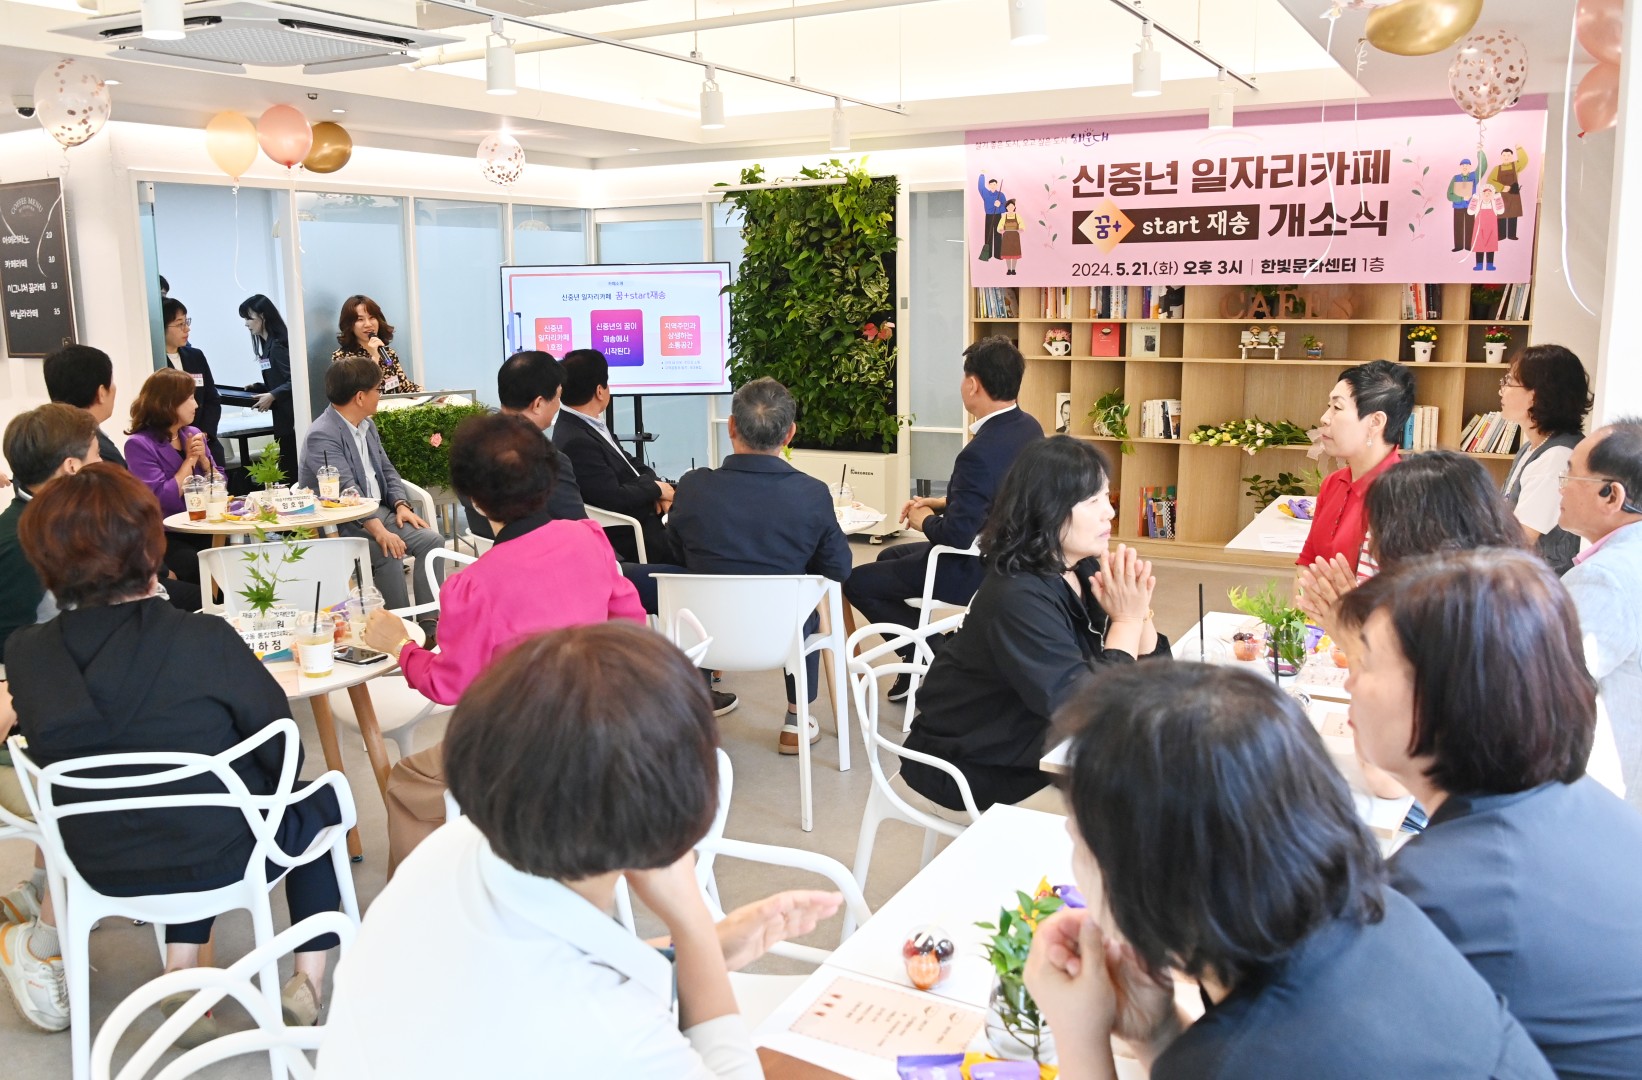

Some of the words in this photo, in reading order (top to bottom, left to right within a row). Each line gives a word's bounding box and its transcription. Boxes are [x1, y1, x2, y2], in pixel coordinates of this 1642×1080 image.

[1072, 160, 1179, 198] 신중년
[1192, 149, 1391, 193] 일자리카페
[1095, 214, 1122, 239] 꿈+
[1142, 213, 1200, 235] start
[1206, 210, 1250, 236] 재송
[1267, 200, 1389, 237] 개소식
[1183, 261, 1213, 275] 오후
[1218, 259, 1242, 274] 3시
[1261, 257, 1356, 274] 한빛문화센터
[1362, 256, 1384, 273] 1층
[561, 293, 580, 301] 신중년
[582, 293, 612, 301] 일자리카페
[544, 324, 563, 333] 신중년
[596, 322, 622, 331] 신중년의
[624, 322, 637, 331] 꿈이
[664, 322, 696, 330] 지역주민과
[538, 333, 570, 342] 일자리카페
[602, 335, 629, 343] 재송에서
[667, 332, 693, 340] 상생하는
[546, 343, 563, 351] 1호점
[667, 341, 693, 349] 소통공간
[604, 347, 631, 356] 시작된다
